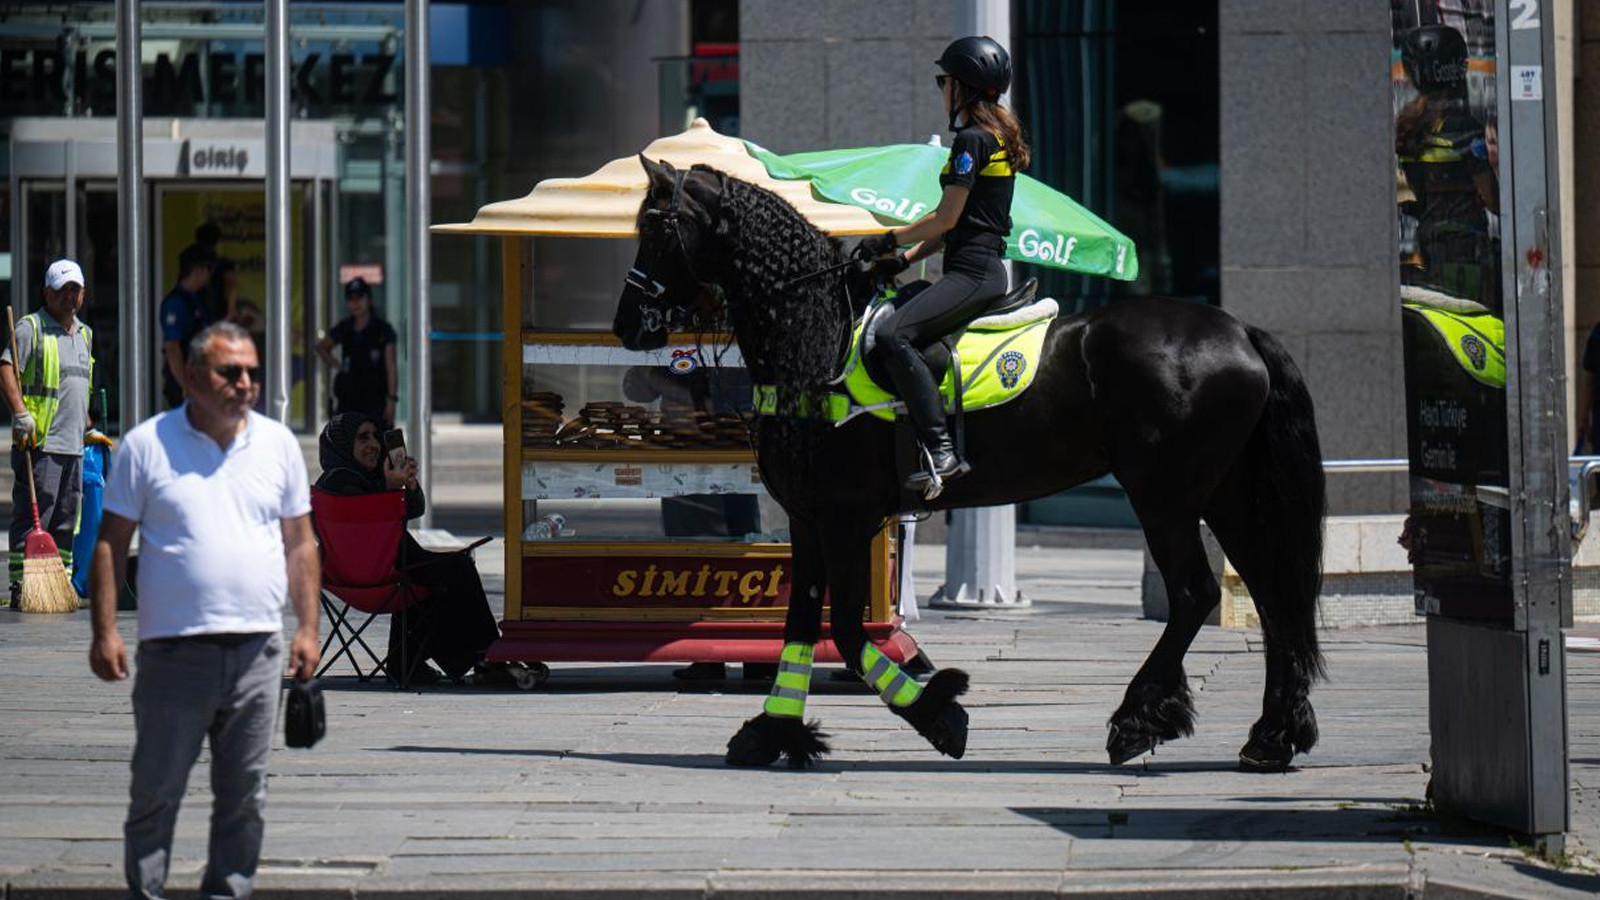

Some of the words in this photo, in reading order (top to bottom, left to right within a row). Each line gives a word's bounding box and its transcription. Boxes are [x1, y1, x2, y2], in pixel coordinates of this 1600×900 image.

[1509, 0, 1540, 30] 2
[153, 52, 397, 103] MERKEZ
[850, 187, 927, 221] Golf
[1018, 229, 1077, 266] Golf
[612, 563, 785, 603] SİMİTÇİ
